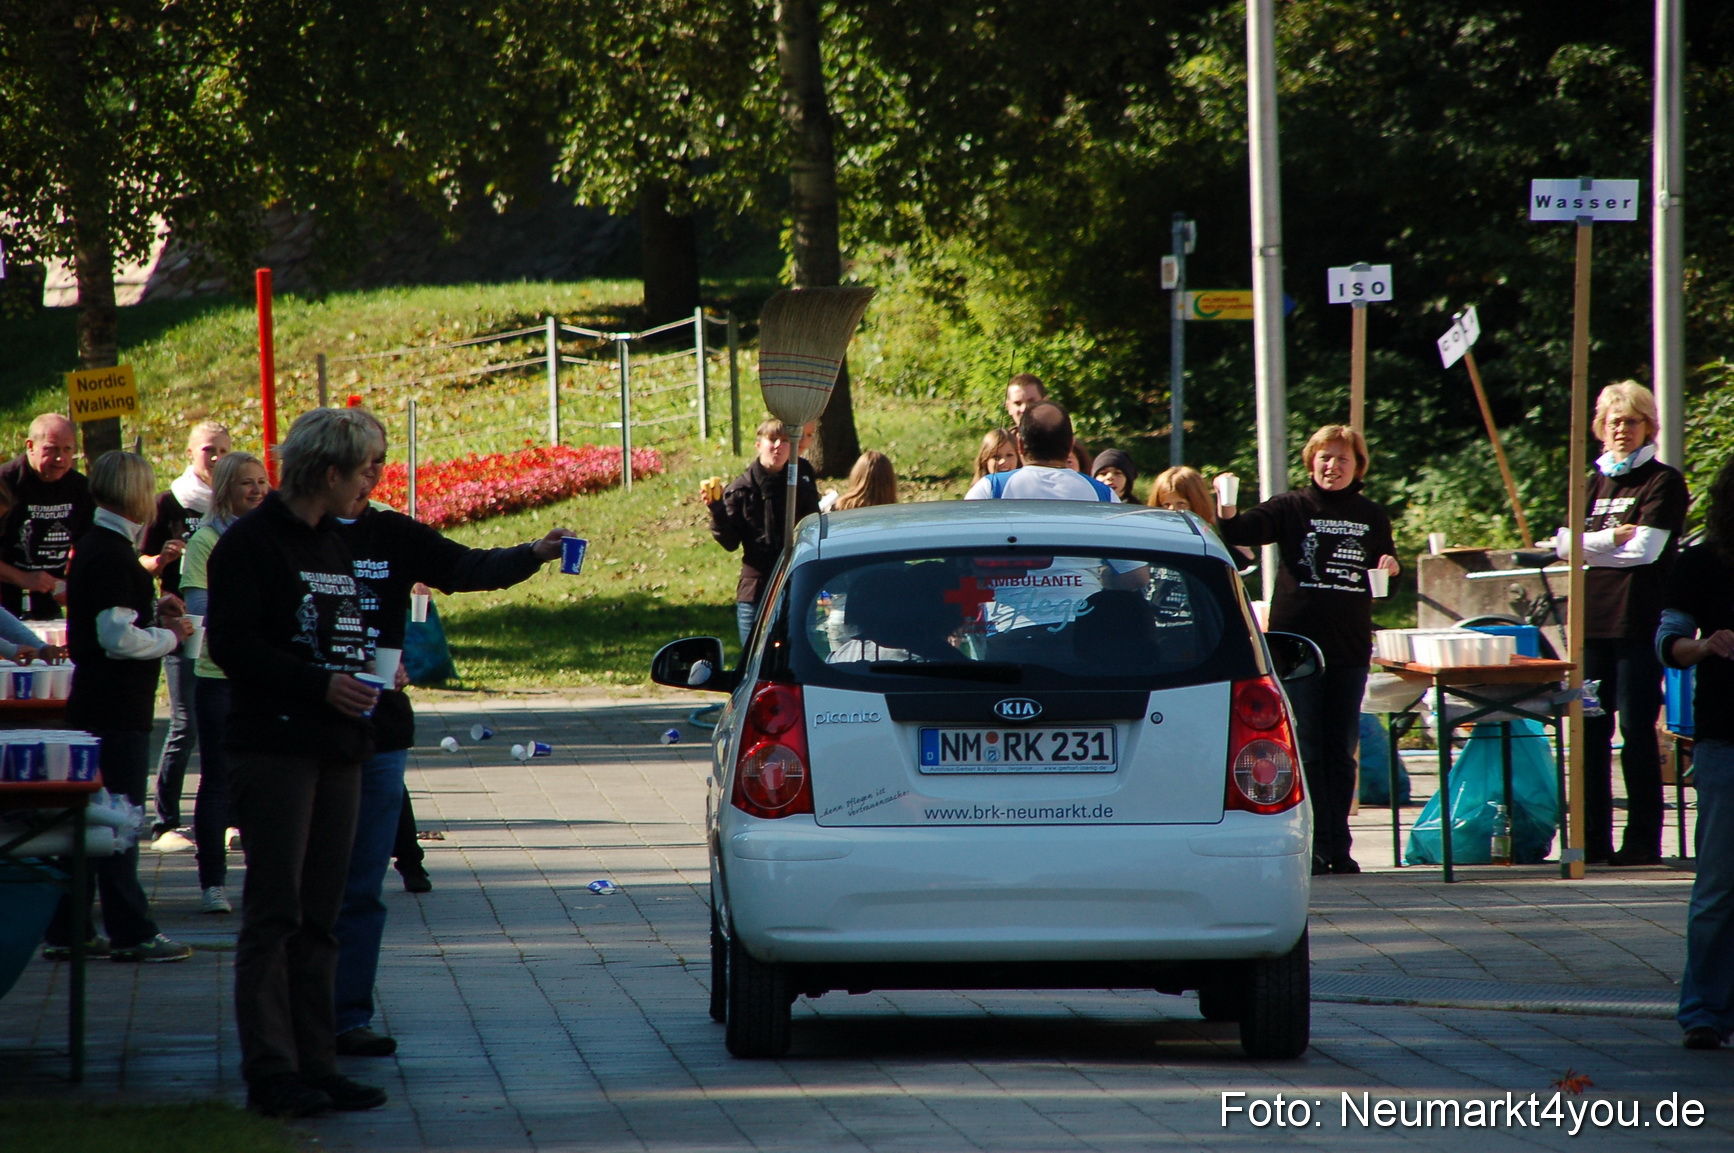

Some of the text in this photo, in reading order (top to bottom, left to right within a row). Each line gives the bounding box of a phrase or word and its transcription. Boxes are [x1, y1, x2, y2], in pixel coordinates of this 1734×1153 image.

[1535, 195, 1632, 209] Wasser
[1339, 281, 1385, 297] ISO
[76, 373, 127, 392] Nordic
[74, 395, 135, 414] Walking
[31, 511, 69, 519] STADTLAUF
[1310, 519, 1370, 531] NEUMARKTER
[1315, 526, 1365, 536] STADTLAUF
[983, 575, 1083, 587] AMBULANTE
[992, 587, 1095, 634] Pflege
[1002, 702, 1035, 715] KIA
[813, 709, 882, 729] picanto
[941, 732, 1110, 761] NM RK 231
[924, 804, 1114, 819] www.brk-neumarkt.de
